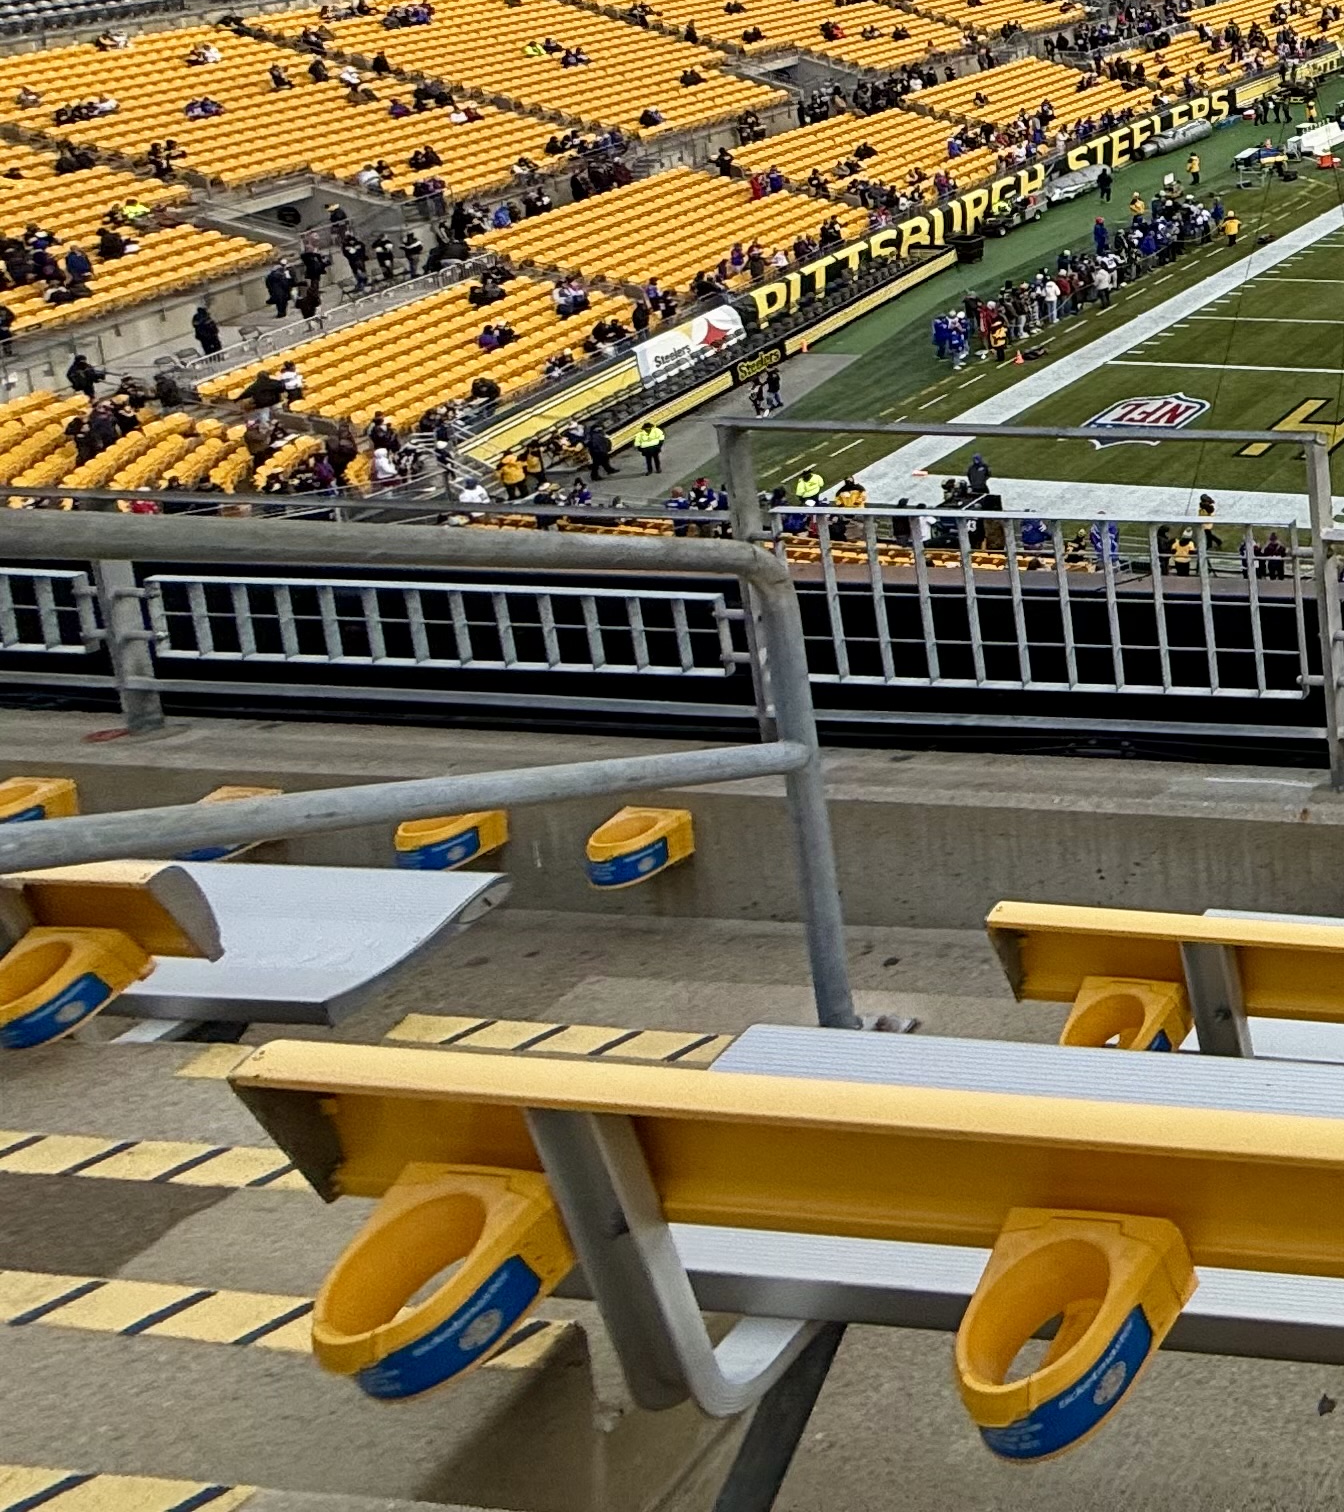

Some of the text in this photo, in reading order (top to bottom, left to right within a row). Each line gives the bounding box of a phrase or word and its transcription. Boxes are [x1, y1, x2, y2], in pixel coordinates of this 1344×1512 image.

[653, 344, 692, 368] Steelers
[737, 349, 781, 381] Steelers
[1118, 401, 1198, 425] NFL
